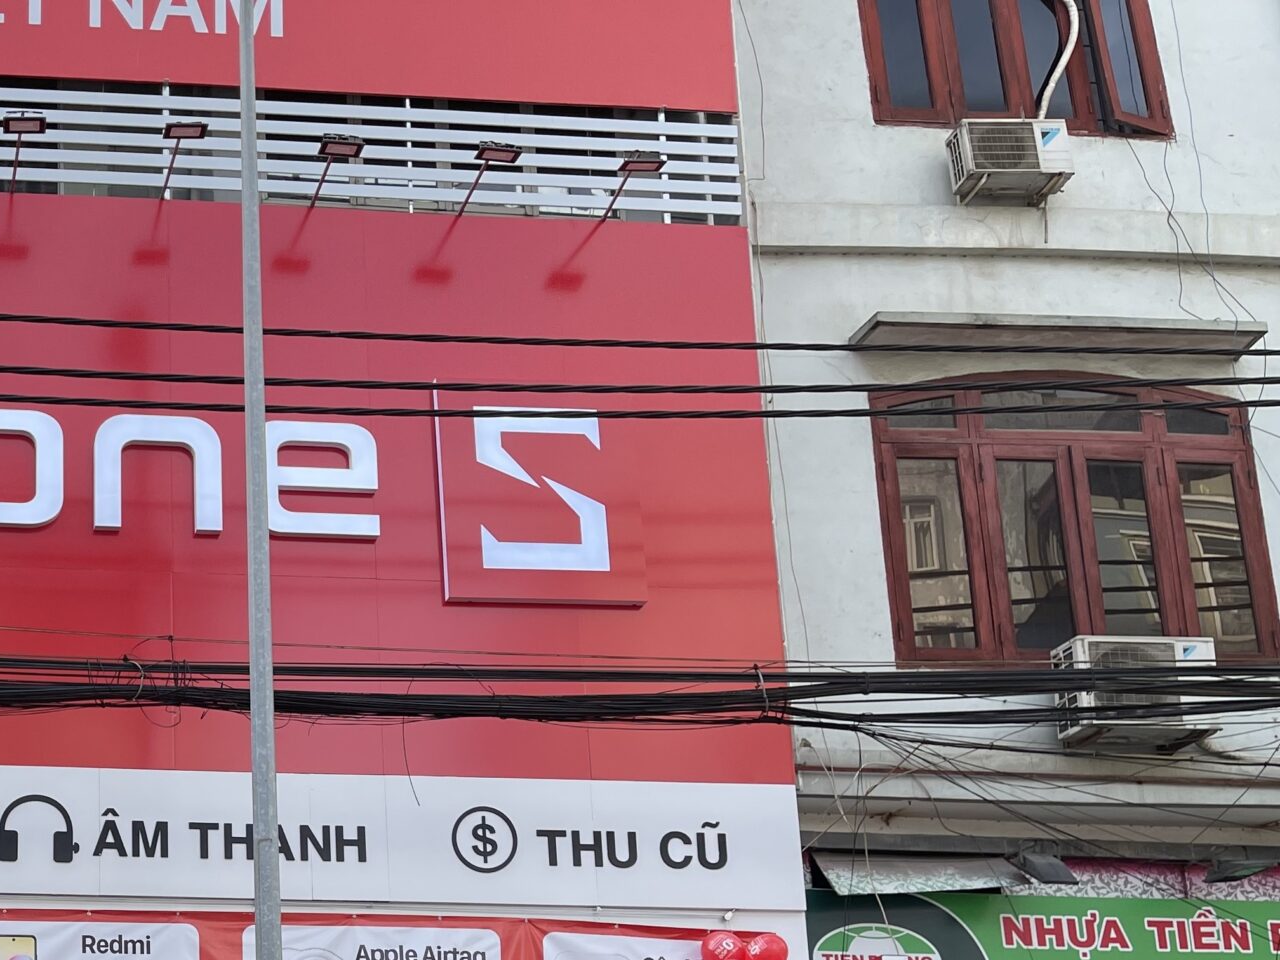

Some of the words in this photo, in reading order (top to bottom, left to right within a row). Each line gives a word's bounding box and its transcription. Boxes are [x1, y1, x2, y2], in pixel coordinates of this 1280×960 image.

[93, 808, 169, 858] ÂM
[536, 830, 638, 869] THU
[659, 821, 728, 870] CŨ
[82, 935, 151, 955] Redmi
[1000, 910, 1132, 959] NHỰA
[1144, 906, 1253, 954] TIỀN
